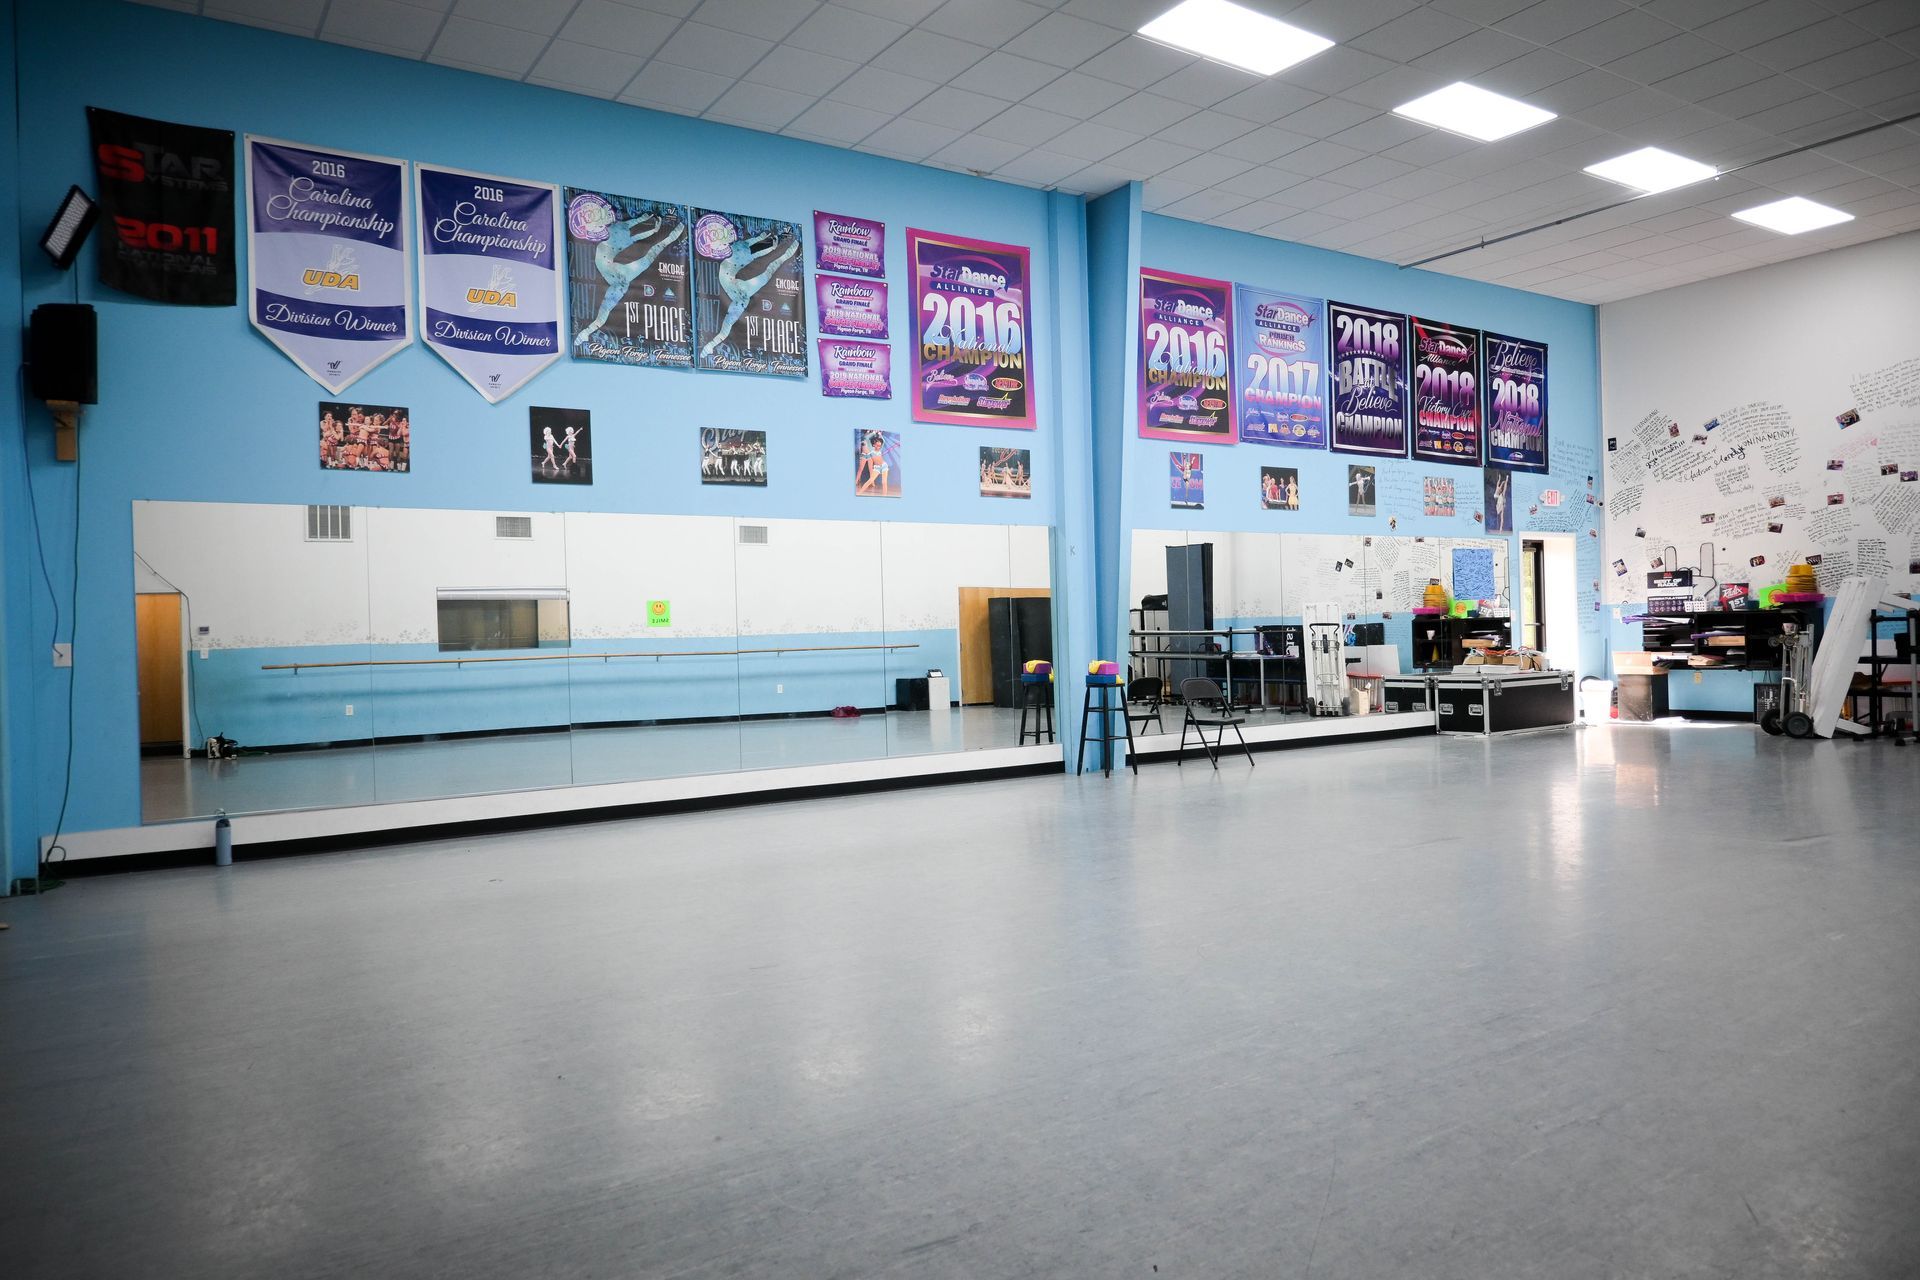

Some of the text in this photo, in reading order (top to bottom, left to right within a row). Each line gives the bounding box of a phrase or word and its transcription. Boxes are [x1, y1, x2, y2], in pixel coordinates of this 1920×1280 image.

[98, 142, 224, 182] STAR
[312, 160, 345, 178] 2016
[289, 175, 373, 209] Carolina
[474, 186, 503, 202] 2016
[267, 194, 393, 239] Championship
[454, 200, 528, 231] Carolina
[113, 214, 218, 255] 2011
[434, 217, 546, 258] Championship
[842, 248, 879, 260] NATIONAL
[303, 268, 359, 290] UDA
[658, 262, 685, 275] ENCORE
[930, 264, 1006, 290] StarDance
[775, 278, 799, 291] ENCORE
[937, 283, 989, 296] ALLIANCE
[467, 288, 517, 307] UDA
[836, 298, 853, 306] GRAND
[1154, 297, 1213, 320] StarDance
[265, 303, 398, 333] Division Winner
[624, 301, 686, 343] 1ST PLACE
[923, 292, 1021, 355] 2016
[1158, 314, 1200, 326] ALLIANCE
[1255, 304, 1309, 326] StarDance
[1259, 320, 1297, 332] ALLIANCE
[434, 320, 551, 347] Division Winner
[744, 316, 801, 355] 1ST PLACE
[932, 324, 1014, 353] National
[1258, 333, 1306, 352] RANKINGS
[1336, 314, 1399, 362] 2018
[588, 343, 621, 358] Pigeon
[653, 349, 692, 362] Tennessee
[923, 343, 1023, 369] CHAMPION
[1147, 322, 1225, 377] 2016
[1419, 337, 1468, 358] StarDance
[1419, 353, 1456, 367] Alliance
[1488, 340, 1539, 373] Believe
[714, 355, 741, 369] Pigeon
[770, 361, 806, 372] Tennessee
[1154, 351, 1218, 377] National
[1248, 353, 1319, 396] 2017
[1149, 368, 1227, 390] CHAMPION
[1339, 357, 1399, 403] BATTLE
[1417, 364, 1475, 405] 2018
[1245, 387, 1321, 409] CHAMPION
[1341, 383, 1397, 416] Believe
[1418, 395, 1451, 420] Victory
[1492, 377, 1539, 416] 2018
[1336, 411, 1402, 440] CHAMPION
[1419, 410, 1475, 432] CHAMPION
[1491, 429, 1543, 451] CHAMPION
[1547, 491, 1558, 505] EXIT
[1728, 597, 1745, 611] 1ST
